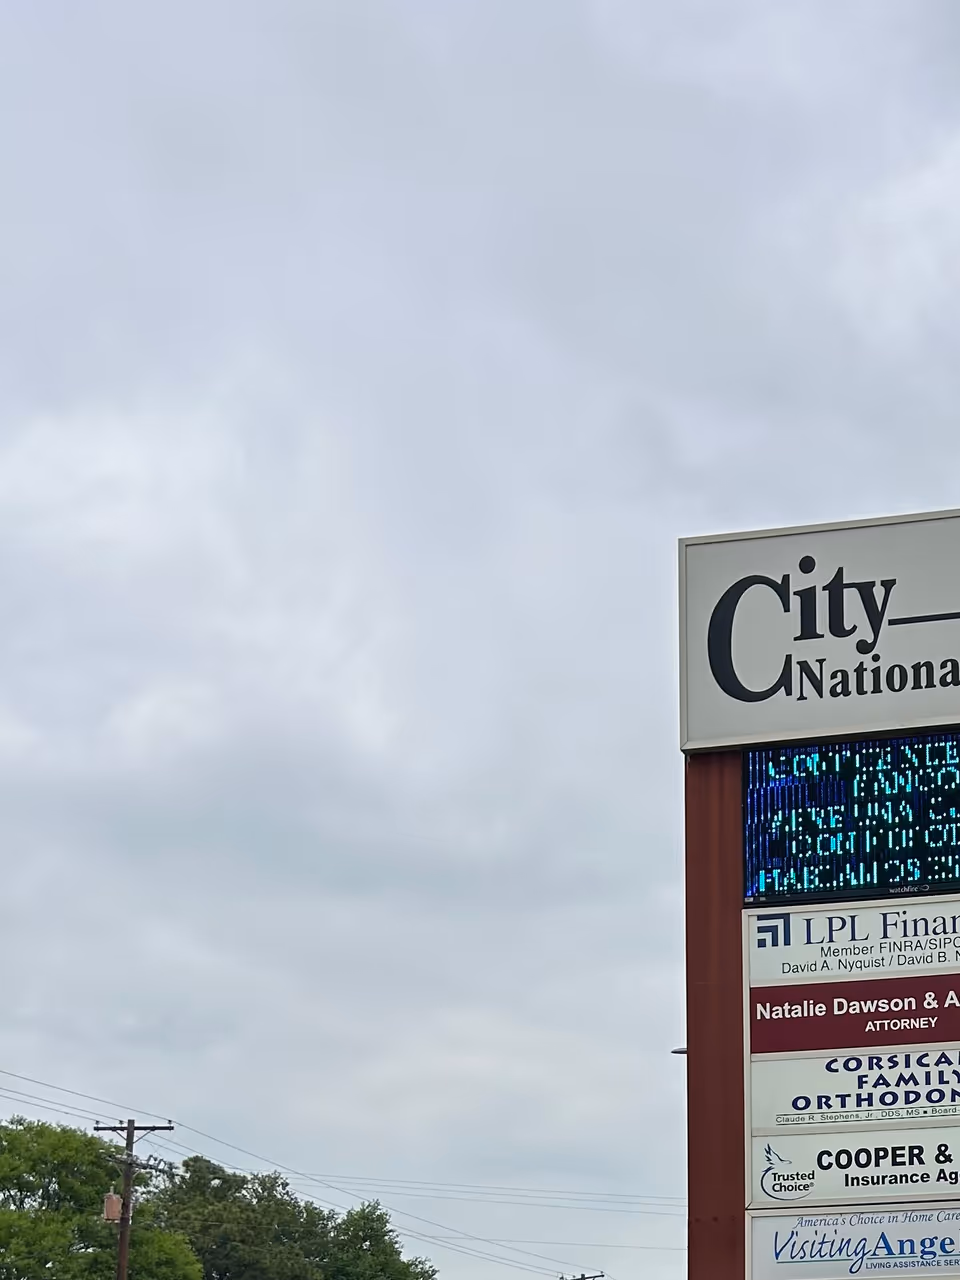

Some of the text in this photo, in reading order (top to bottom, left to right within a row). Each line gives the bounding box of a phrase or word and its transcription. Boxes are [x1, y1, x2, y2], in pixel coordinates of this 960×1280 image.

[707, 555, 897, 702] City
[803, 914, 870, 945] LPL
[820, 944, 874, 958] Member
[781, 961, 817, 974] David
[820, 959, 834, 972] A.
[838, 957, 885, 972] Nyquist
[897, 952, 933, 966] David
[938, 951, 951, 963] B.
[756, 999, 827, 1020] Natalie
[833, 994, 916, 1016] Dawson
[924, 992, 939, 1009] &
[865, 1016, 938, 1032] ATTORNEY
[776, 1114, 805, 1123] Claude
[905, 1108, 921, 1117] MS
[817, 1145, 925, 1170] COOPER
[935, 1143, 953, 1164] &
[771, 1169, 815, 1182] Trusted
[845, 1169, 931, 1188] Insurance
[794, 1214, 846, 1229] America's
[849, 1213, 885, 1226] Choice
[888, 1213, 898, 1223] in
[901, 1210, 934, 1223] Home
[865, 1261, 892, 1270] LIVING
[893, 1259, 942, 1269] ASSISTANCE
